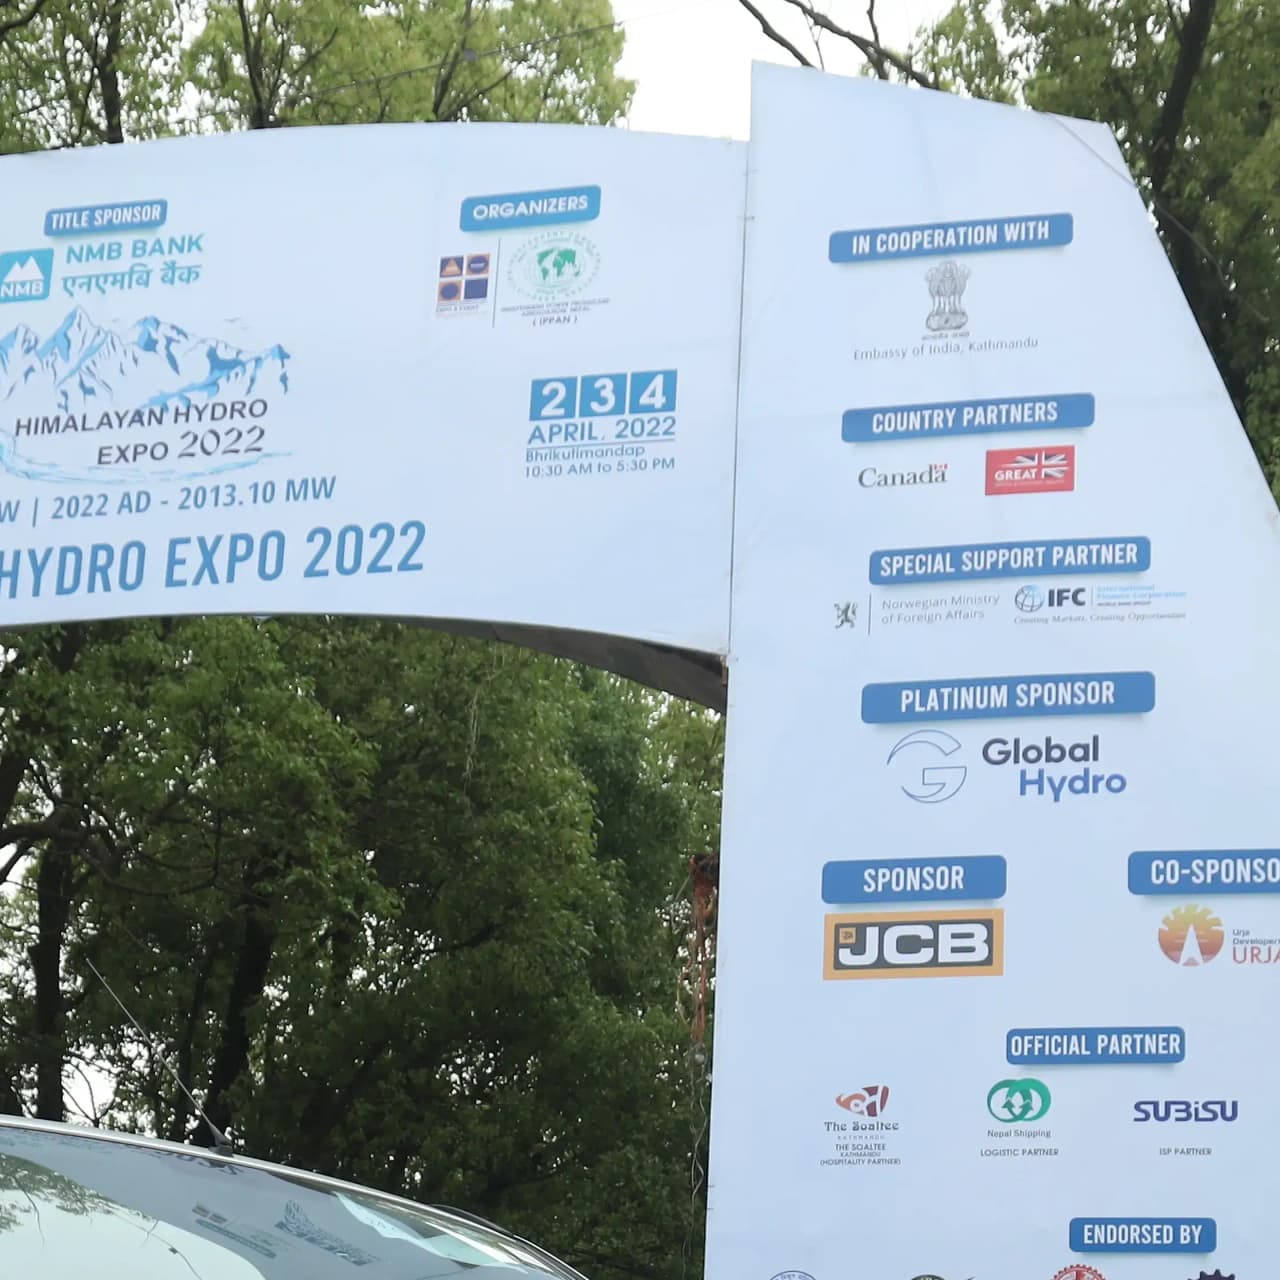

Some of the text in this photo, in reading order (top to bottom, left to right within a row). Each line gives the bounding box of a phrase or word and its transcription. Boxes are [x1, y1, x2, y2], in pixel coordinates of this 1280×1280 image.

[51, 204, 161, 230] TITLE SPONSOR
[473, 195, 588, 220] ORGANIZERS
[66, 233, 205, 264] NMB BANK
[852, 220, 1049, 255] IN COOPERATION WITH
[0, 279, 44, 299] NMB
[853, 336, 1038, 361] Embassy of India, Kathmandu
[540, 374, 666, 417] 2 3 4
[14, 398, 268, 437] HIMALAYAN HYDRO
[615, 416, 676, 439] 2022
[872, 401, 1058, 434] COUNTRY PARTNERS
[96, 425, 266, 466] EXPO 2022
[525, 445, 645, 463] Bhrikutimandap
[525, 457, 675, 478] 10:30 AM to 5:30 PM
[858, 464, 948, 488] Canada
[994, 468, 1038, 482] GREAT
[51, 493, 108, 520] 2022
[117, 490, 151, 515] AD
[178, 480, 275, 510] 2013.10
[285, 475, 337, 501] MW
[165, 530, 286, 588] EXPO
[303, 520, 426, 578] 2022
[880, 543, 1138, 577] SPECIAL SUPPORT PARTNER
[882, 594, 1000, 612] Norwegian Ministry
[1048, 588, 1086, 607] IFC
[881, 608, 984, 626] of Foreign Affairs
[901, 681, 1114, 712] PLATINUM SPONSOR
[982, 735, 1099, 765] Global
[1020, 768, 1127, 802] Hydro
[863, 866, 964, 893] SPONSOR
[838, 923, 989, 966] JCB
[1011, 1033, 1181, 1056] OFFICIAL PARTNER
[824, 1120, 899, 1132] The Soaltee
[987, 1128, 1051, 1139] Nepal Shipping
[852, 1143, 886, 1151] SOALTEE
[980, 1148, 1059, 1157] LOGISTIC PARTNER
[1159, 1147, 1212, 1156] ISP PARTNER
[1083, 1224, 1202, 1245] ENDORSED BY
